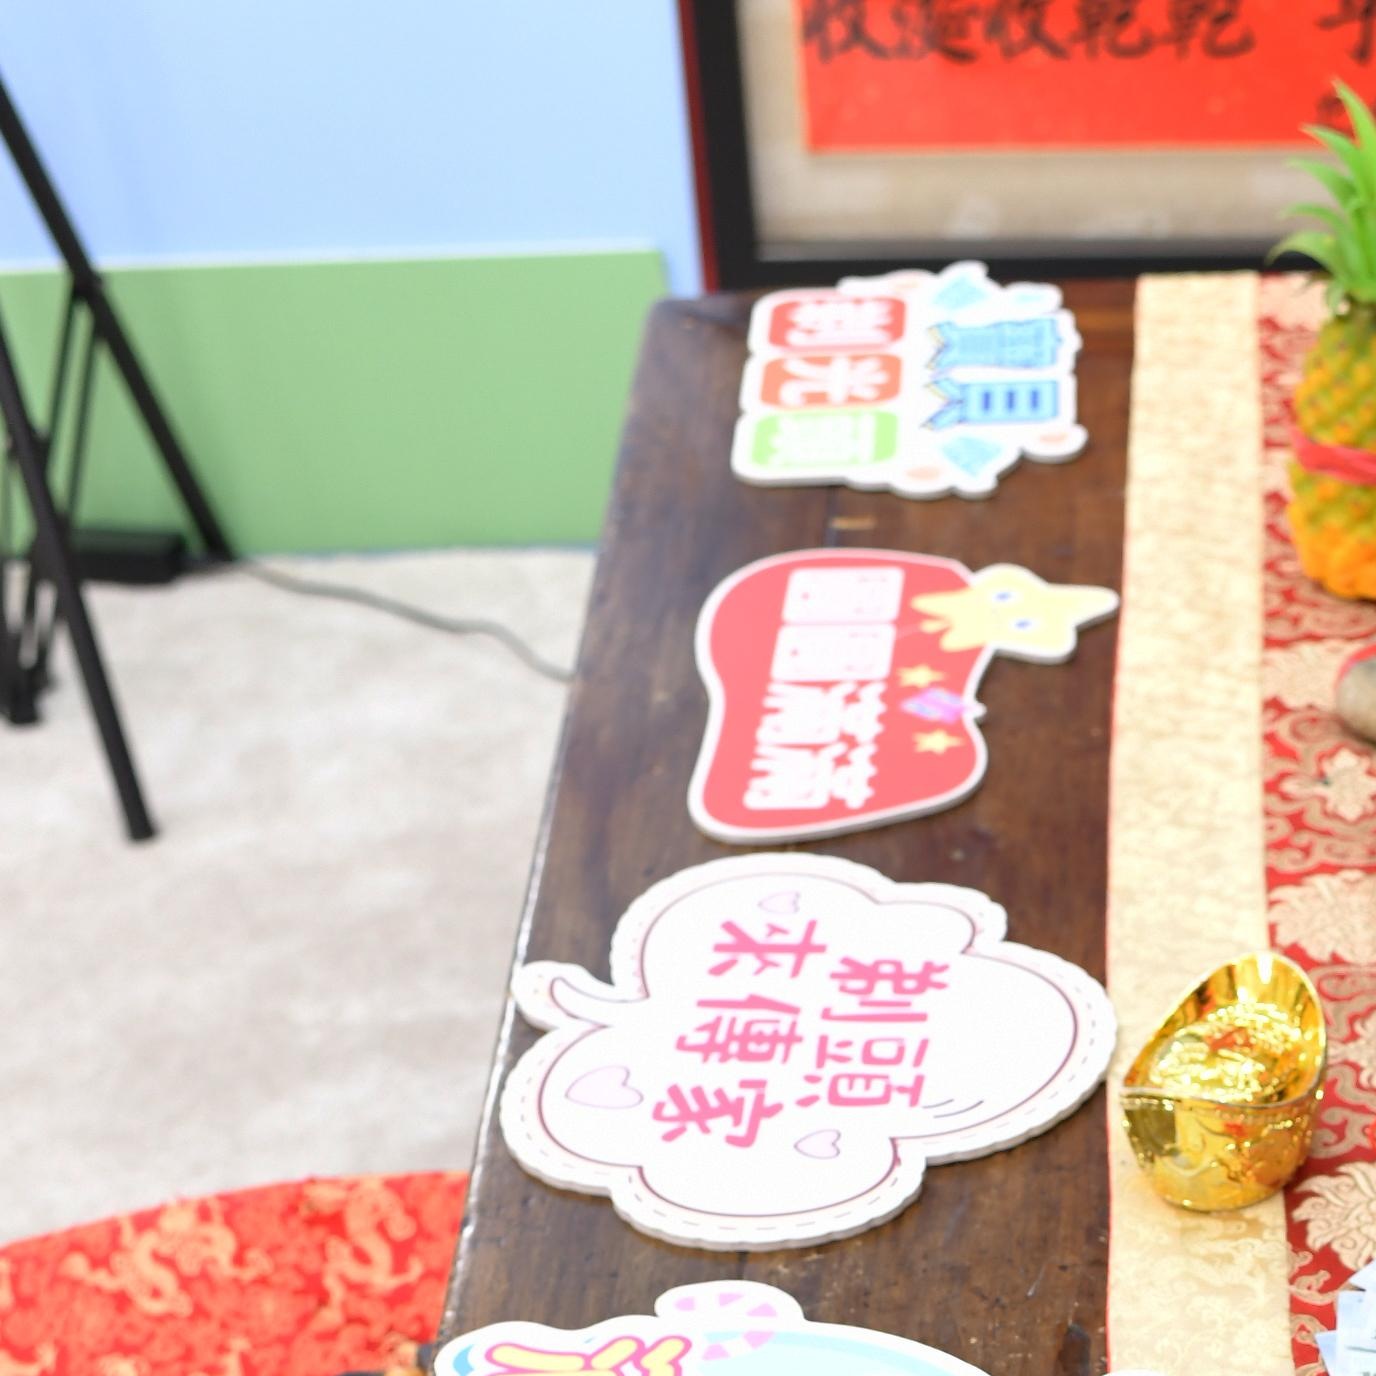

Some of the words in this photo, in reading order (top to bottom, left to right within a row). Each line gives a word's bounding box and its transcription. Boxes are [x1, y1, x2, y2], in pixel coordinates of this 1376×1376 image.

[651, 917, 827, 1147] 來傳家
[797, 954, 950, 1111] 剃頭
